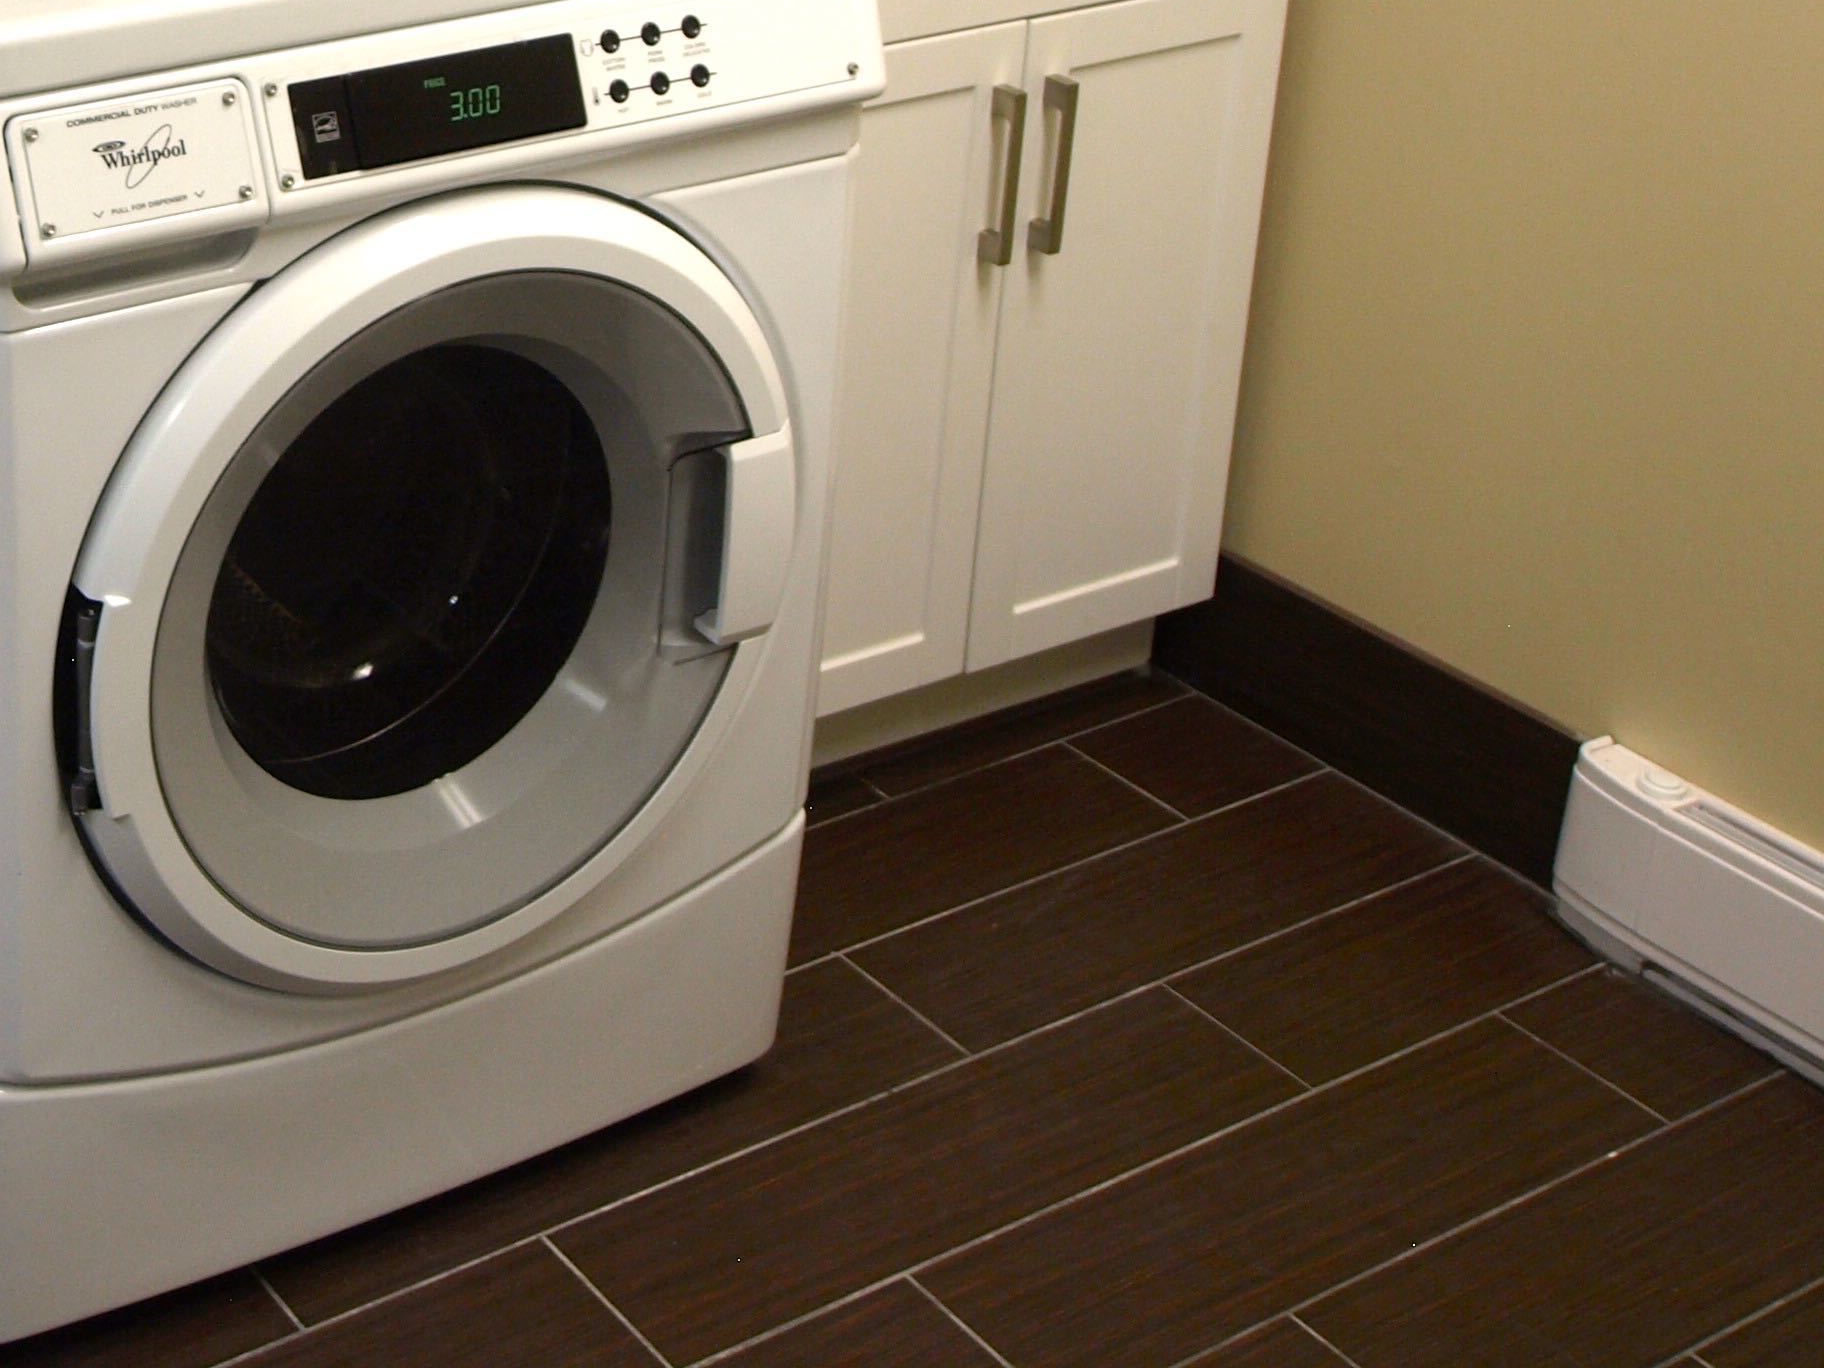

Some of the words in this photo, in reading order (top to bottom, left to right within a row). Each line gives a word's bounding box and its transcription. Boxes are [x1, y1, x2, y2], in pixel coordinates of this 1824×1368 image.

[66, 110, 131, 128] COMMERCIAL
[134, 104, 158, 116] DUTY
[161, 97, 197, 110] WASHER
[450, 84, 501, 121] 3.00
[101, 139, 187, 171] Whirlpool
